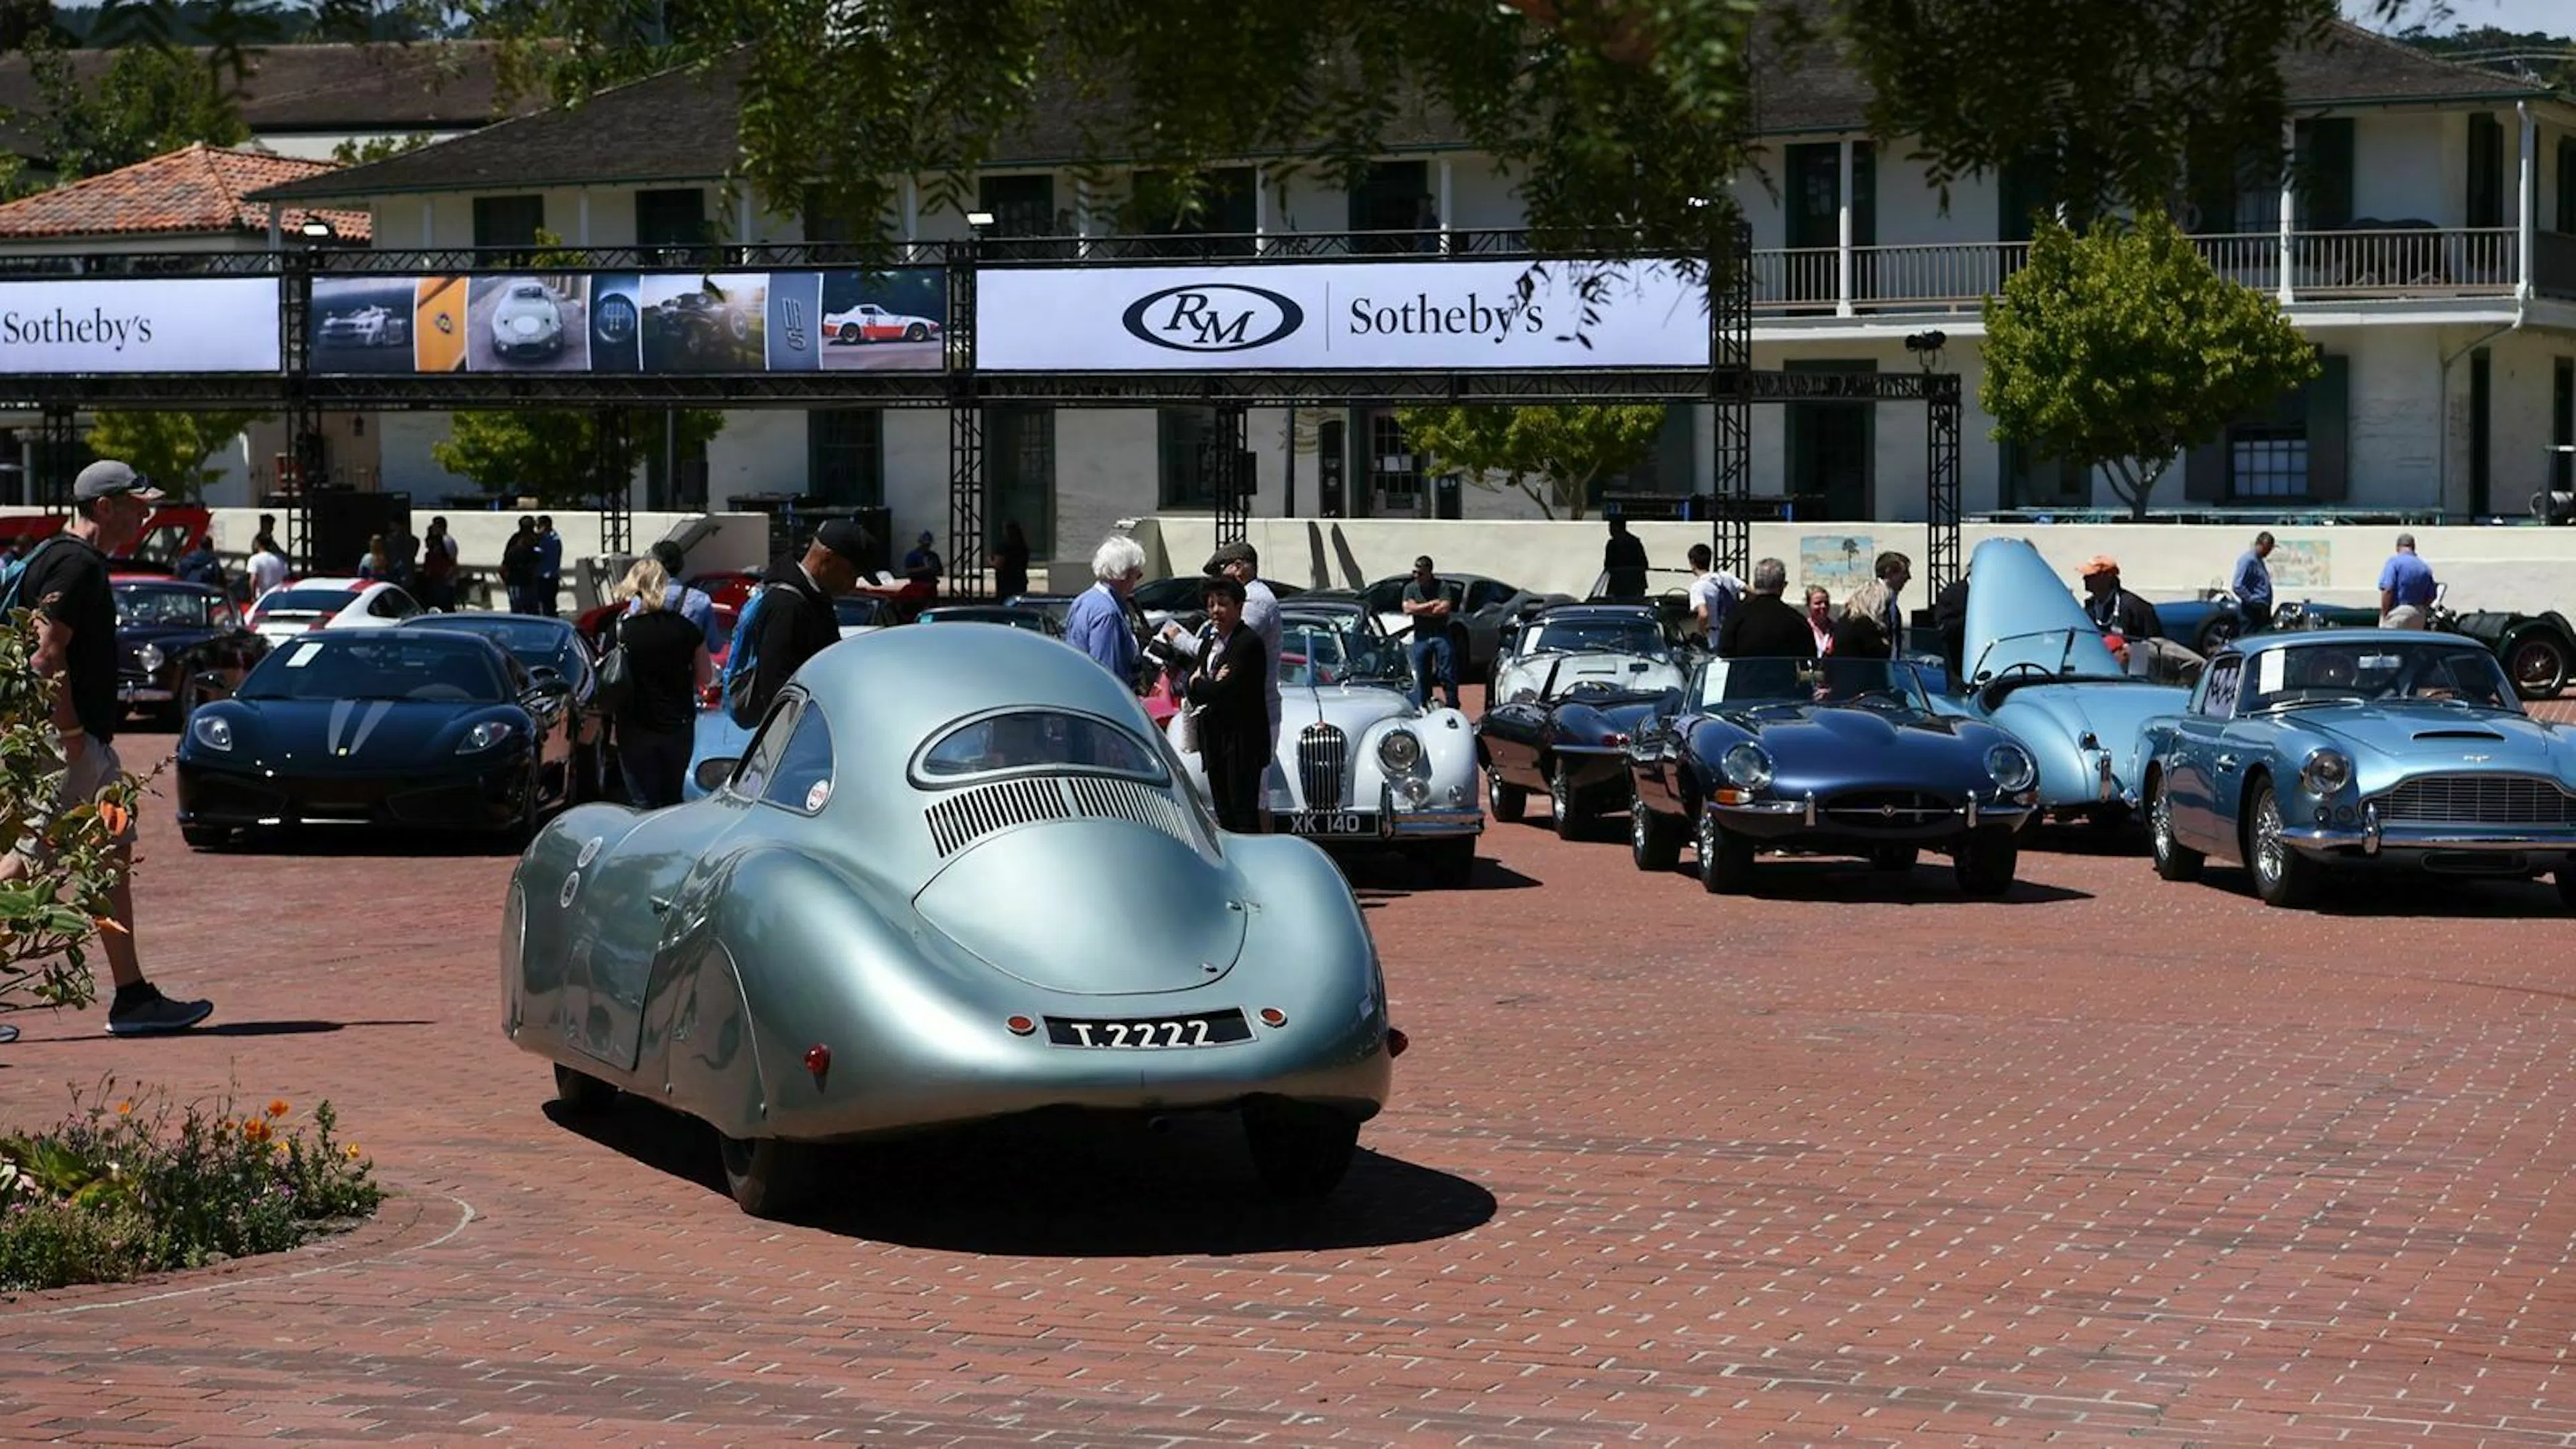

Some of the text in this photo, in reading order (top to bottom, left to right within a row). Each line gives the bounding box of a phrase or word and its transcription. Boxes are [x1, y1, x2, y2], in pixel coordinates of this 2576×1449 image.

[3, 307, 153, 352] Sotheby's
[1162, 292, 1544, 344] RM Sotheby's
[1290, 814, 1360, 834] XK 140
